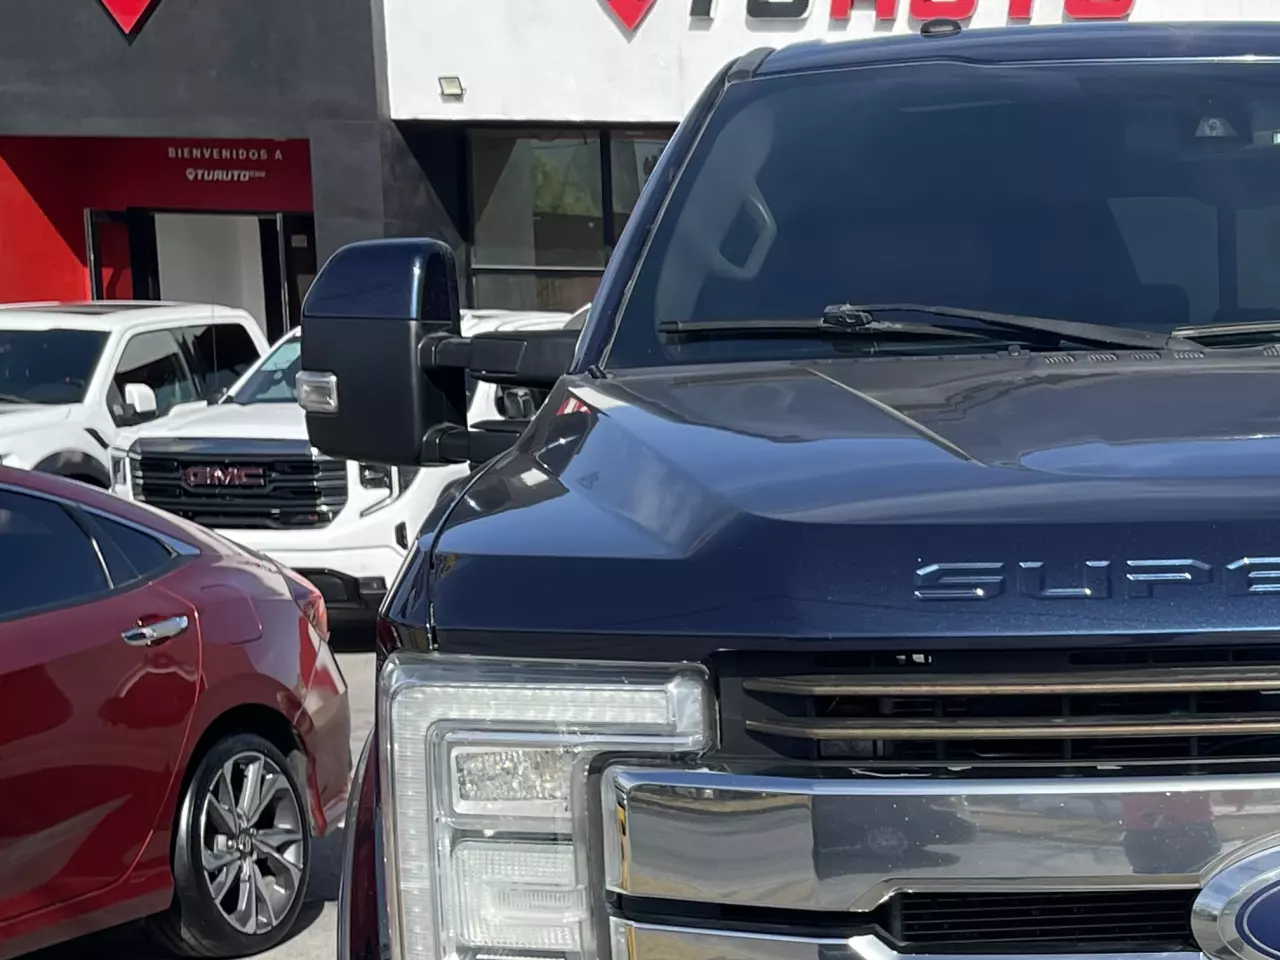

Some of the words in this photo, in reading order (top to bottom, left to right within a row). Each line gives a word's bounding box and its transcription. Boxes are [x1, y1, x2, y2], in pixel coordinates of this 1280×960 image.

[168, 147, 268, 160] BIENVENIDOS
[275, 149, 283, 160] A
[185, 466, 264, 486] GMC
